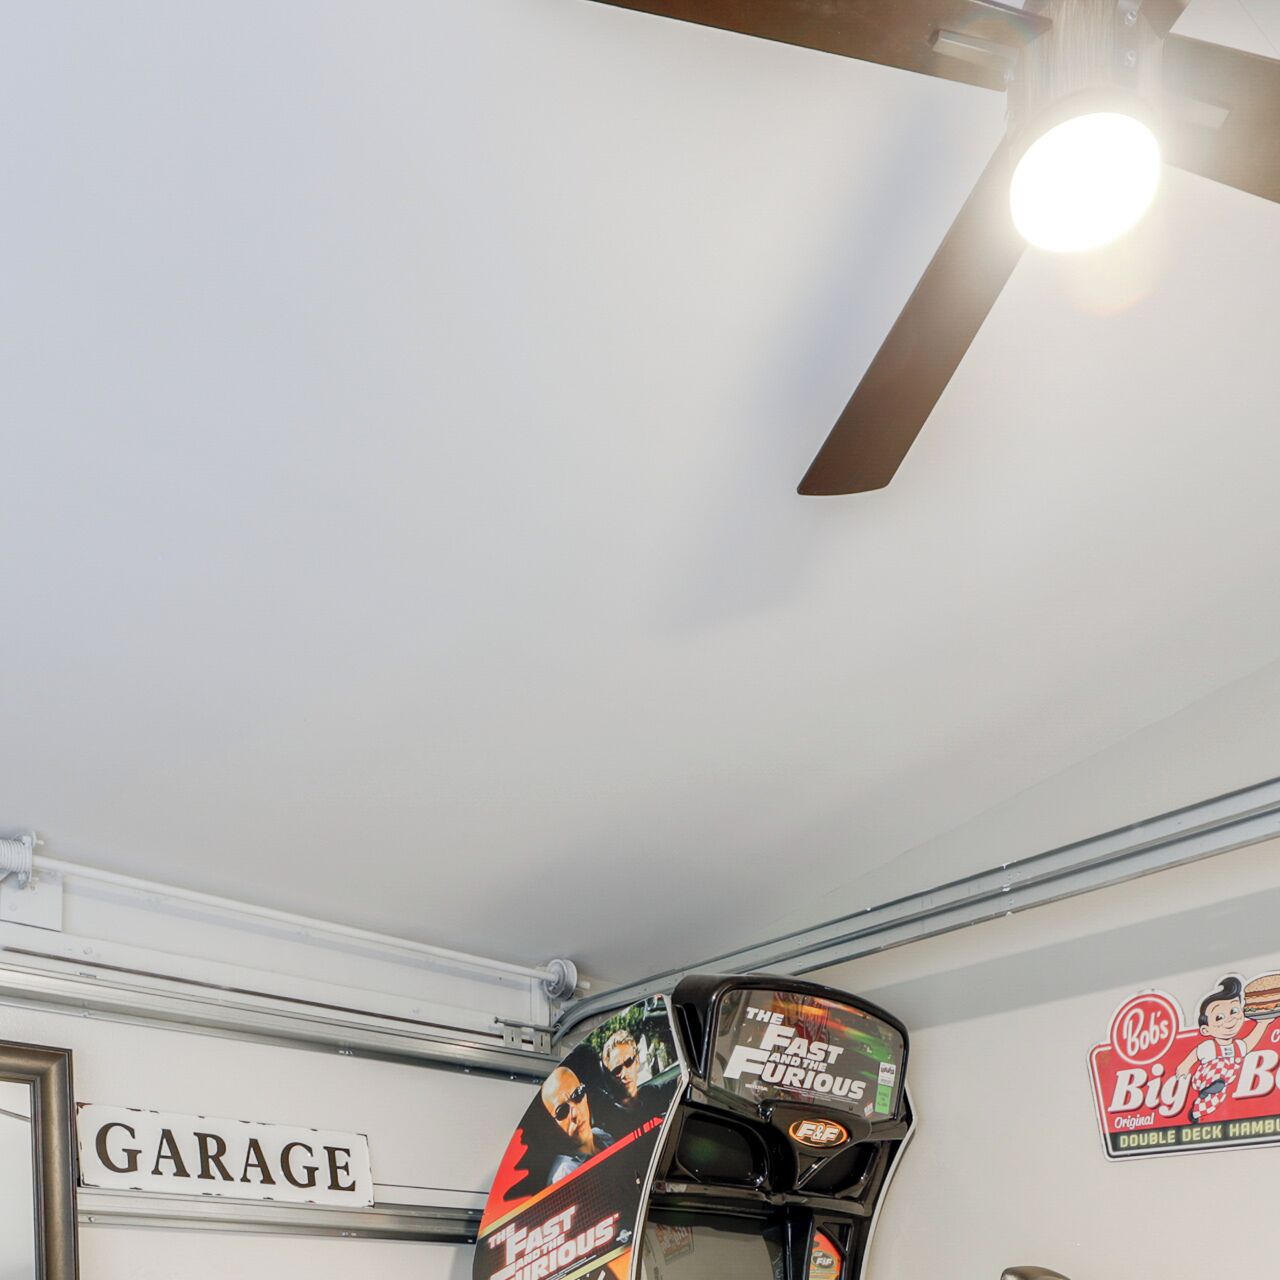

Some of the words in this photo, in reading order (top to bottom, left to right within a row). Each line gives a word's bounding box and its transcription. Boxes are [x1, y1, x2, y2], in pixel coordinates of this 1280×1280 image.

[746, 1006, 785, 1025] THE
[1123, 1007, 1169, 1057] Bob's
[759, 1023, 844, 1064] FAST
[723, 1045, 867, 1100] FURIOUS
[768, 1052, 801, 1067] AND
[801, 1057, 827, 1072] THE
[1108, 1063, 1191, 1118] Big
[795, 1120, 841, 1143] F&F
[1114, 1112, 1155, 1130] Original
[1120, 1128, 1176, 1148] DOUBLE
[1182, 1122, 1222, 1142] DECK
[95, 1122, 356, 1192] GARAGE
[487, 1223, 516, 1249] THE
[506, 1205, 576, 1266] FAST
[515, 1250, 540, 1269] AND
[541, 1233, 566, 1253] THE
